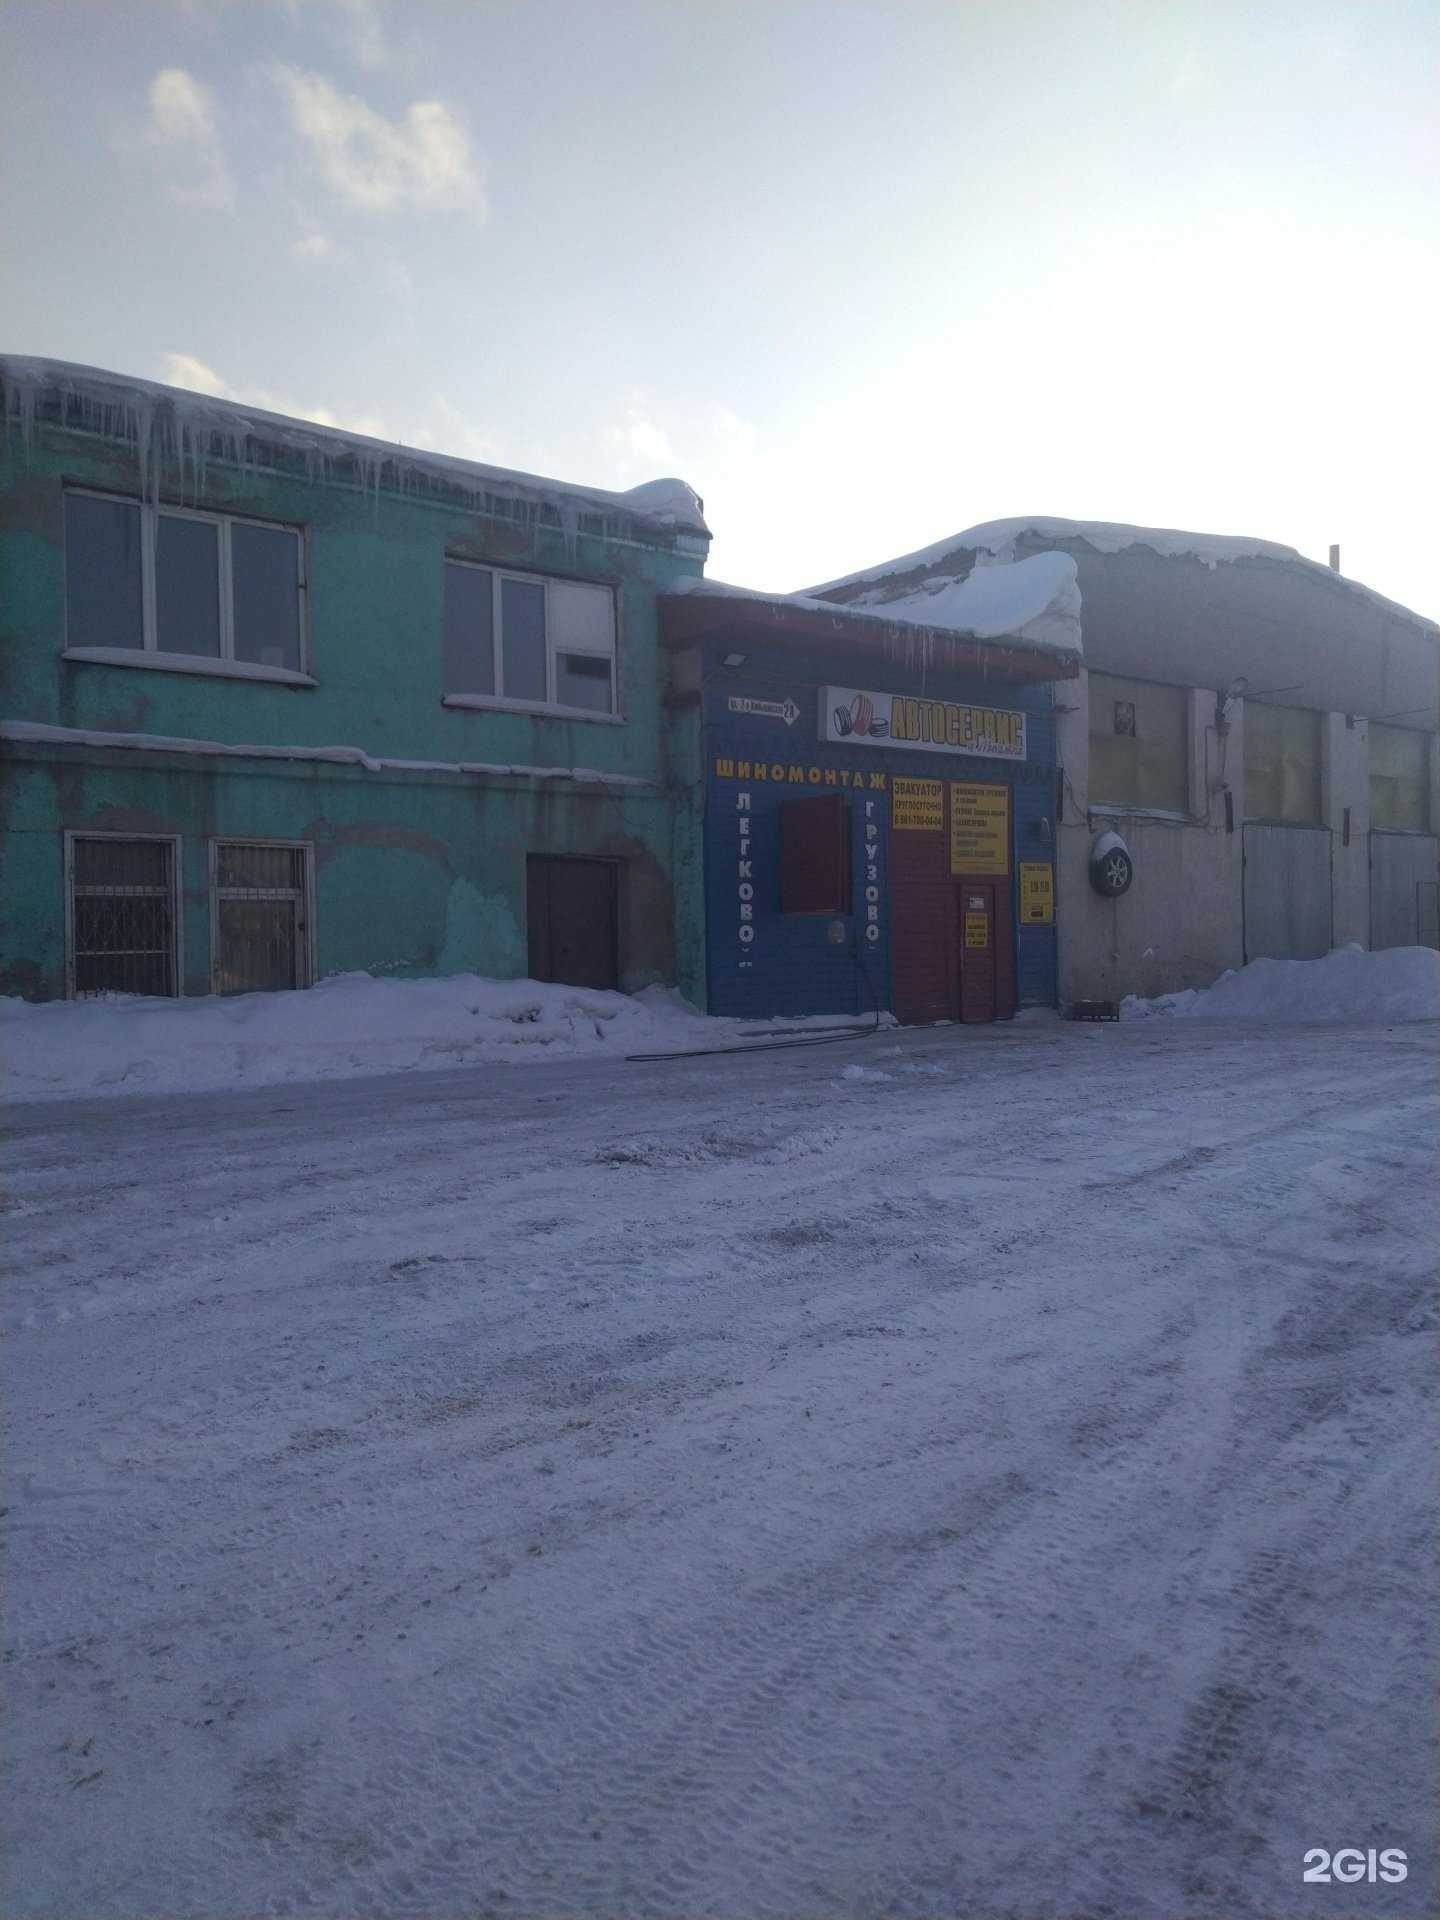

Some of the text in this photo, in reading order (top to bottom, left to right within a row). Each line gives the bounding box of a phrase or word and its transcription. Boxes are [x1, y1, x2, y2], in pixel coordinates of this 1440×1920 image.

[890, 696, 1023, 747] АВТОСЕРВИС
[716, 759, 886, 790] ШИНОМОНТАЖ
[894, 782, 943, 796] ЭВАКУАТОР
